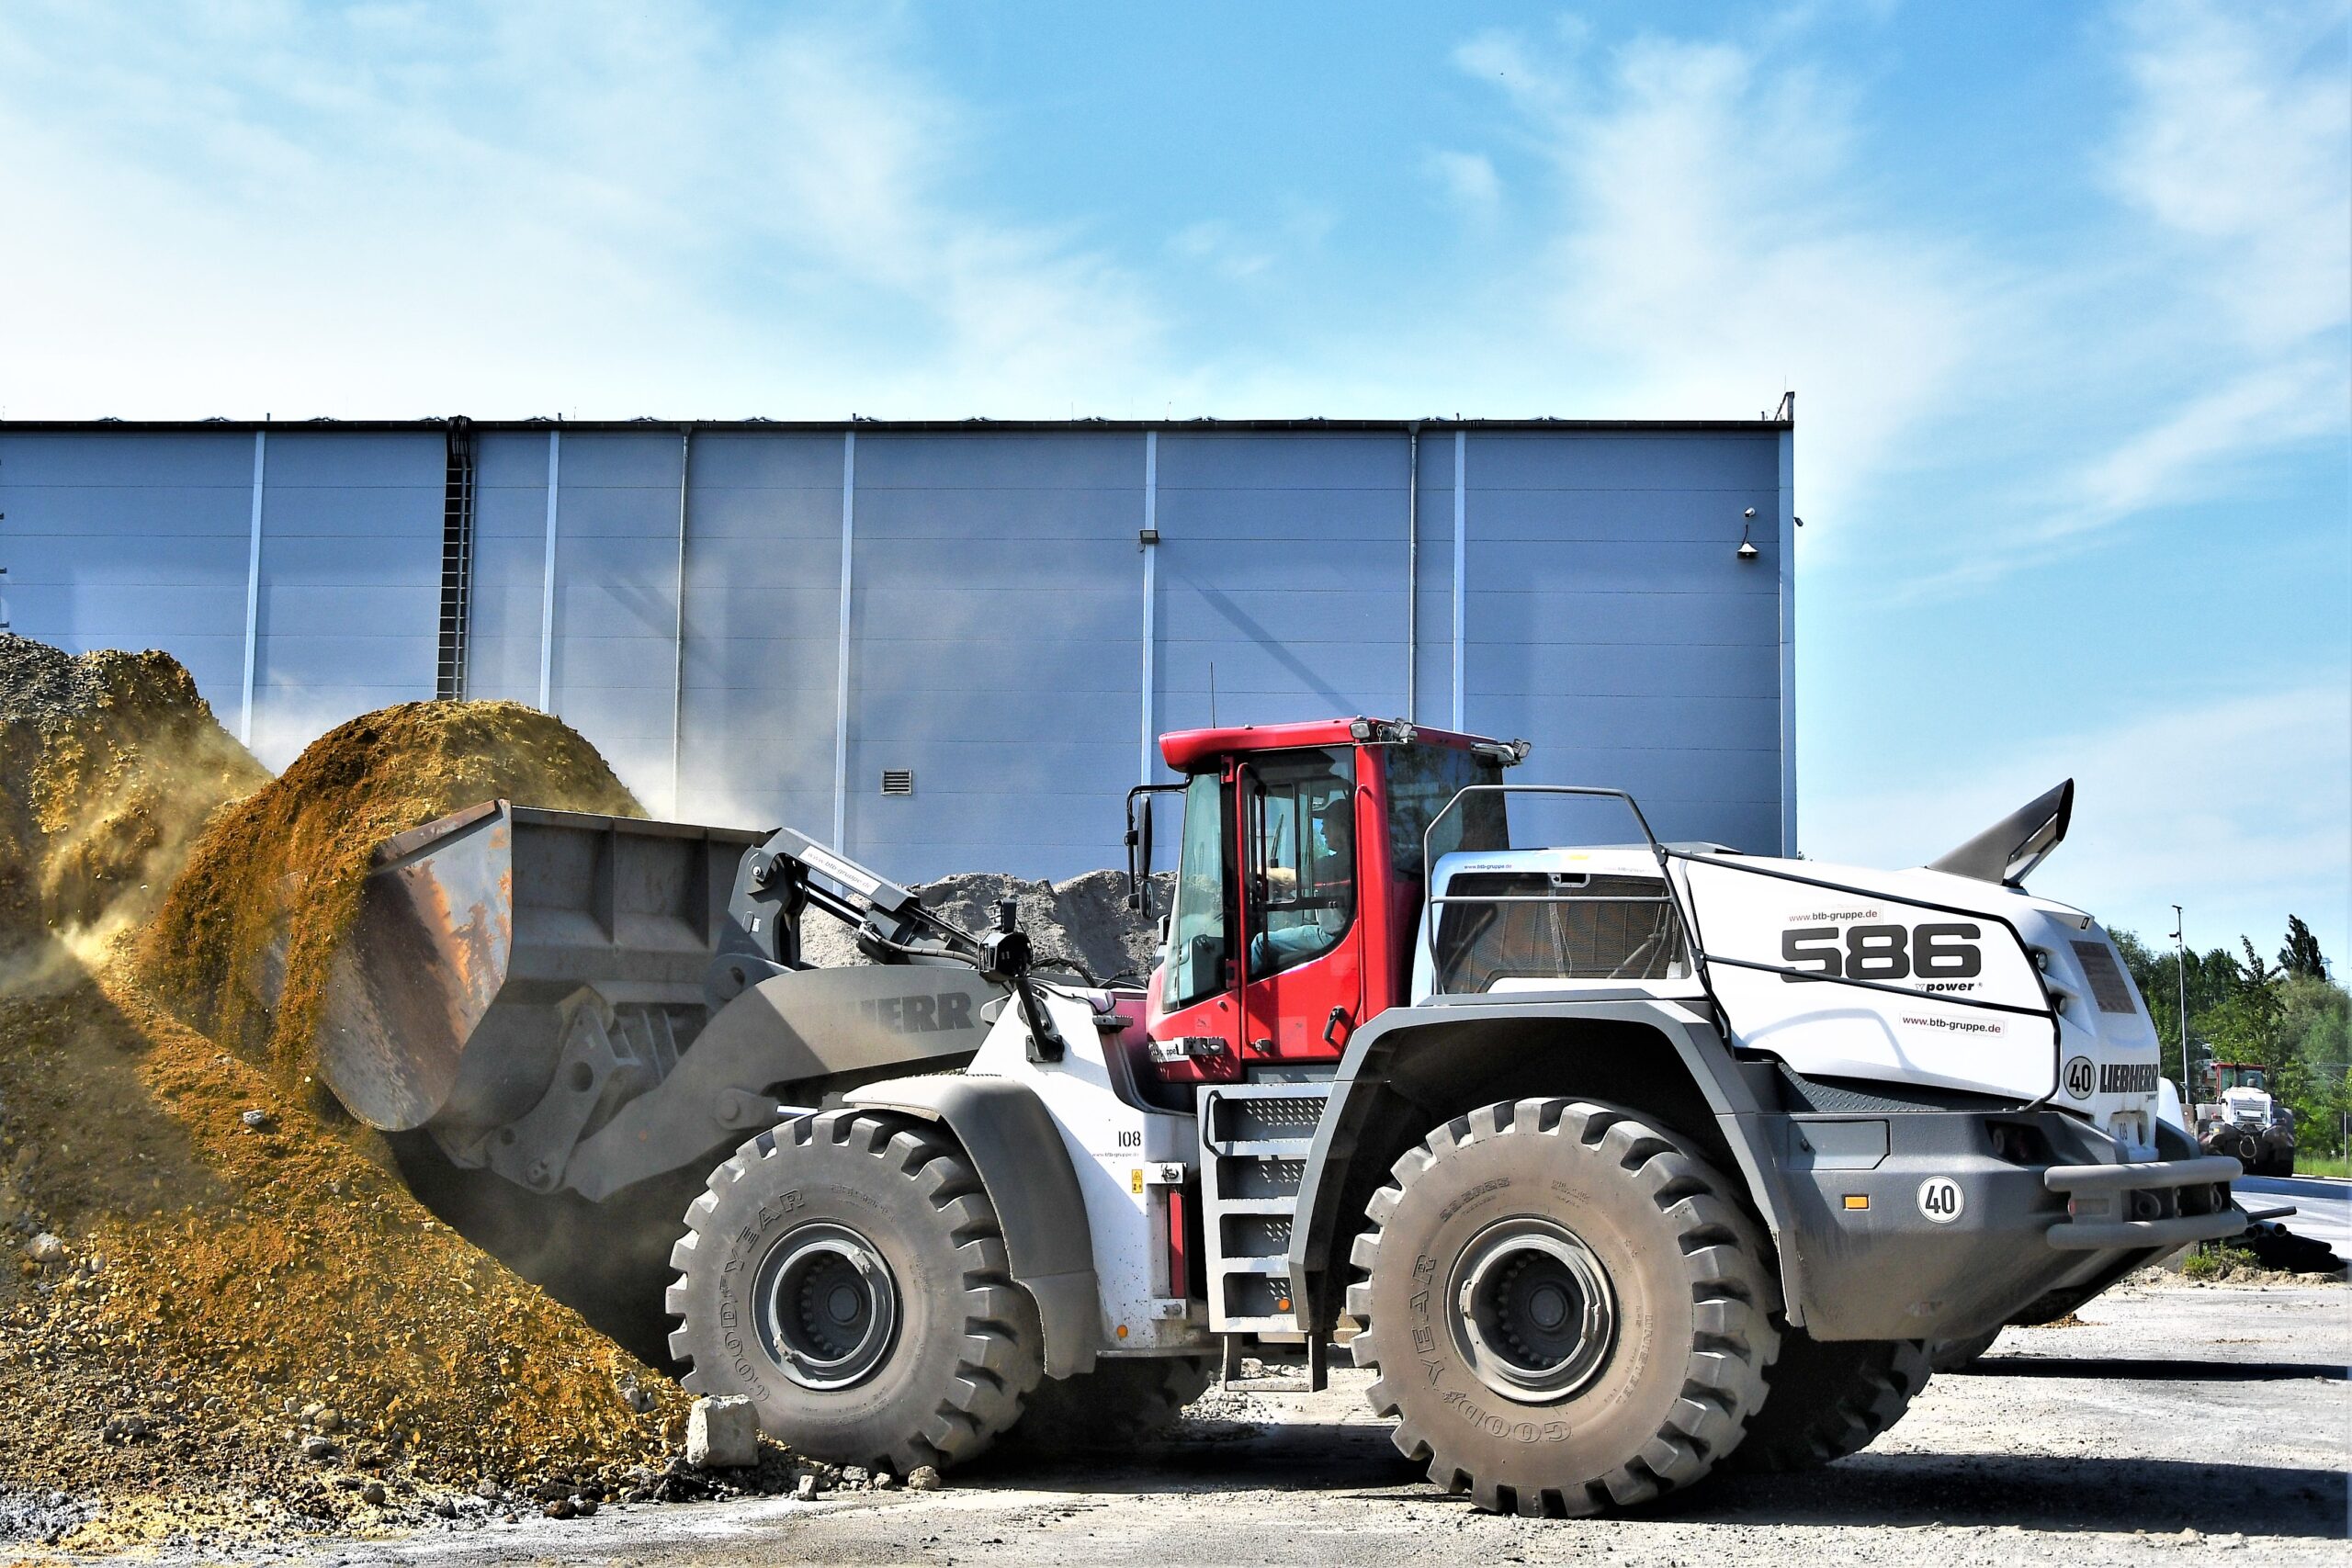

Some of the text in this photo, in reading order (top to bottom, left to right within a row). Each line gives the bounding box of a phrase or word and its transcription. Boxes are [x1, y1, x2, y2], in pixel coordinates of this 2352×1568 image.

[1789, 908, 1878, 922] www.btb-gruppe.de
[1781, 923, 1982, 983] 586
[1902, 1016, 2001, 1033] www.btb-gruppe.de
[2069, 1064, 2091, 1092] 40
[2099, 1064, 2158, 1093] LIEBHERR
[1118, 1131, 1141, 1147] 108
[1925, 1185, 1955, 1214] 40
[1409, 1253, 1572, 1444] GOODYEAR
